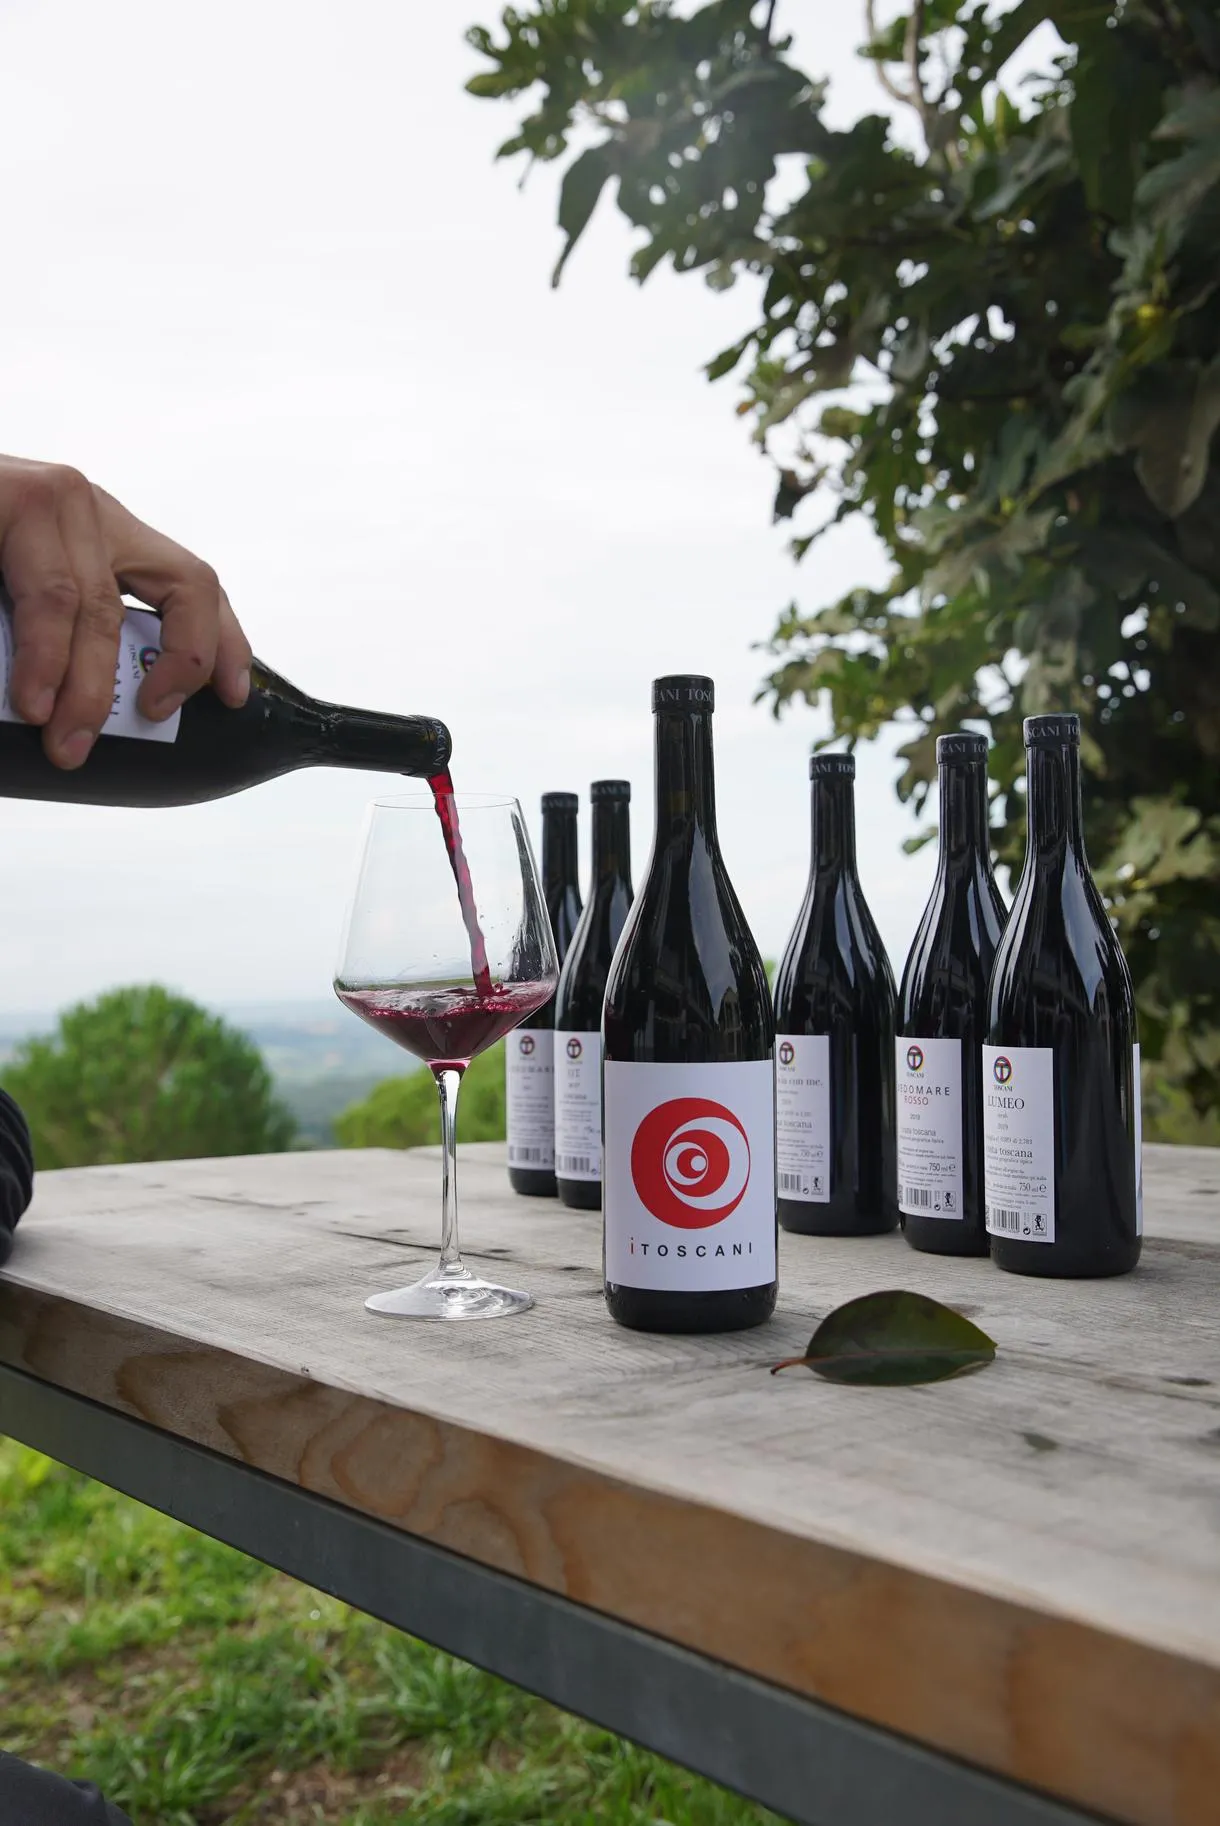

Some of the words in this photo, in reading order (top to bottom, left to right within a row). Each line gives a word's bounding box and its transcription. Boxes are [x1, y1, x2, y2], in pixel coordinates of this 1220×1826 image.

[988, 1096, 1025, 1110] LUMEO
[1000, 1147, 1033, 1158] toscana
[929, 1162, 941, 1172] 750
[1019, 1182, 1031, 1192] 750
